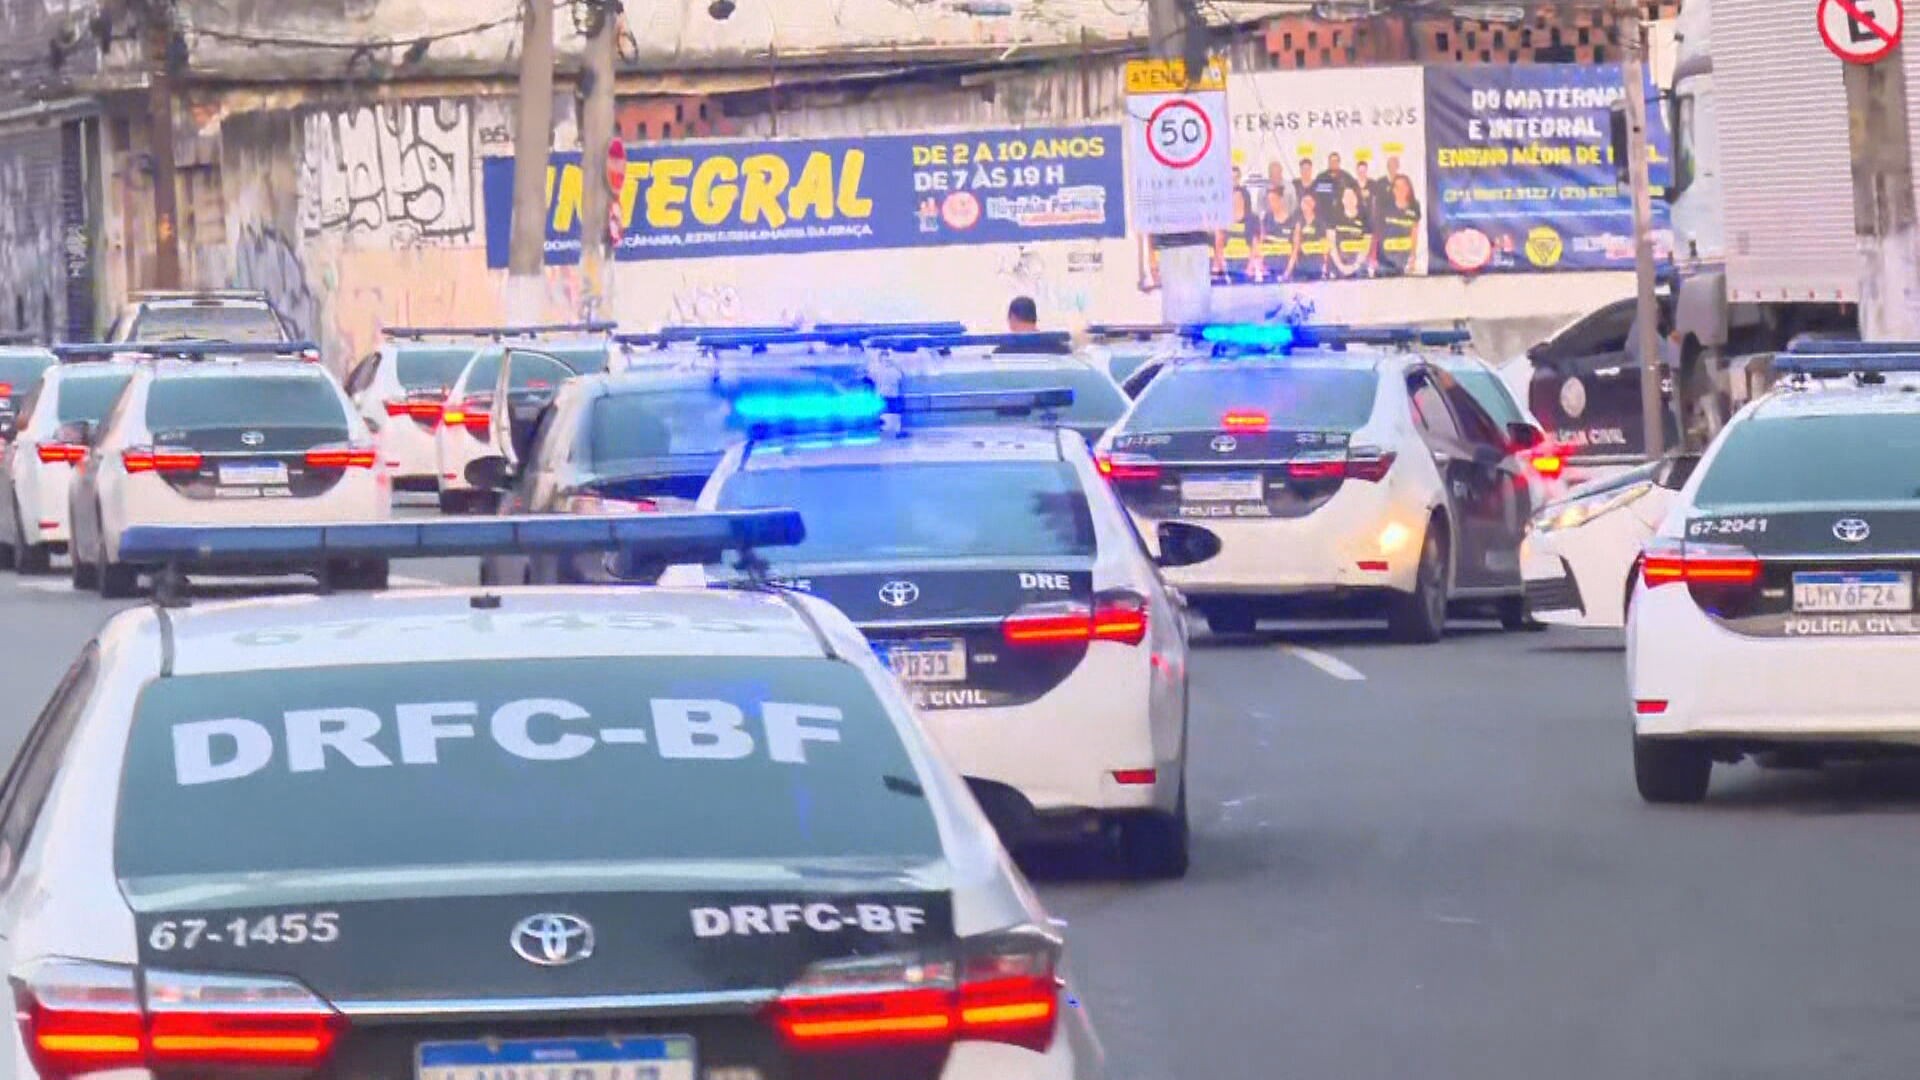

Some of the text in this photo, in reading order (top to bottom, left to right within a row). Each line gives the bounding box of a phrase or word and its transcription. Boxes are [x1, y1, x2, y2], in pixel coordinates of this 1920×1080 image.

[1471, 86, 1626, 110] DO MATERNA
[1307, 110, 1362, 128] PARA
[1468, 116, 1602, 139] E INTEGRAL
[1161, 119, 1200, 145] 50
[913, 137, 1105, 165] DE 2 A 10 ANOS
[914, 171, 948, 191] DE
[953, 170, 968, 188] 7
[1013, 167, 1039, 186] 19
[1046, 165, 1065, 184] H
[1689, 518, 1767, 535] 67-2041
[1019, 573, 1070, 590] DRE
[929, 689, 988, 706] CIVIL
[172, 698, 843, 786] DRFC-BF
[150, 911, 340, 951] 67-1455
[690, 902, 926, 937] DRFC-BF
